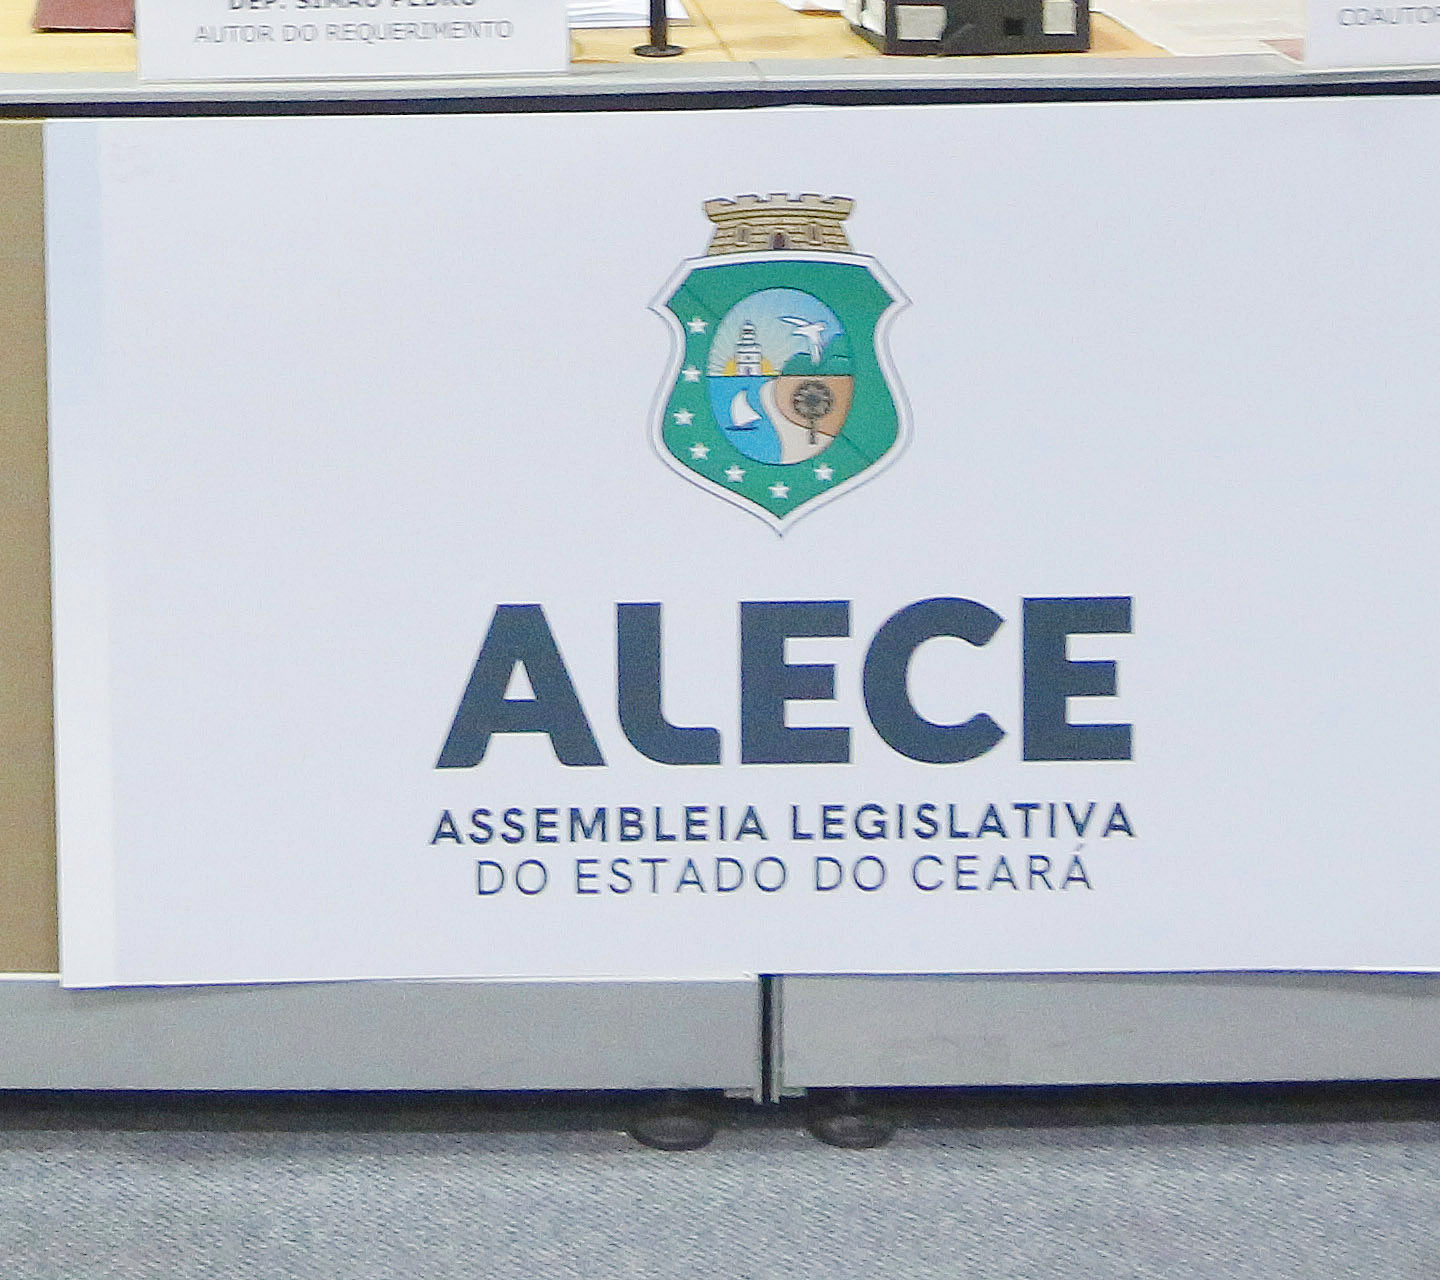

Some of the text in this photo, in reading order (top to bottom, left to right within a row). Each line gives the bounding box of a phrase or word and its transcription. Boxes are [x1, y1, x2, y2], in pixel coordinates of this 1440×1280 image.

[194, 19, 514, 45] AUTOR DO REQUERIMENTO
[433, 595, 1135, 769] ALECE
[430, 800, 1137, 846] ASSEMBLEIA LEGISLATIVA
[476, 844, 1093, 896] DO ESTADO DO CEARÁ
